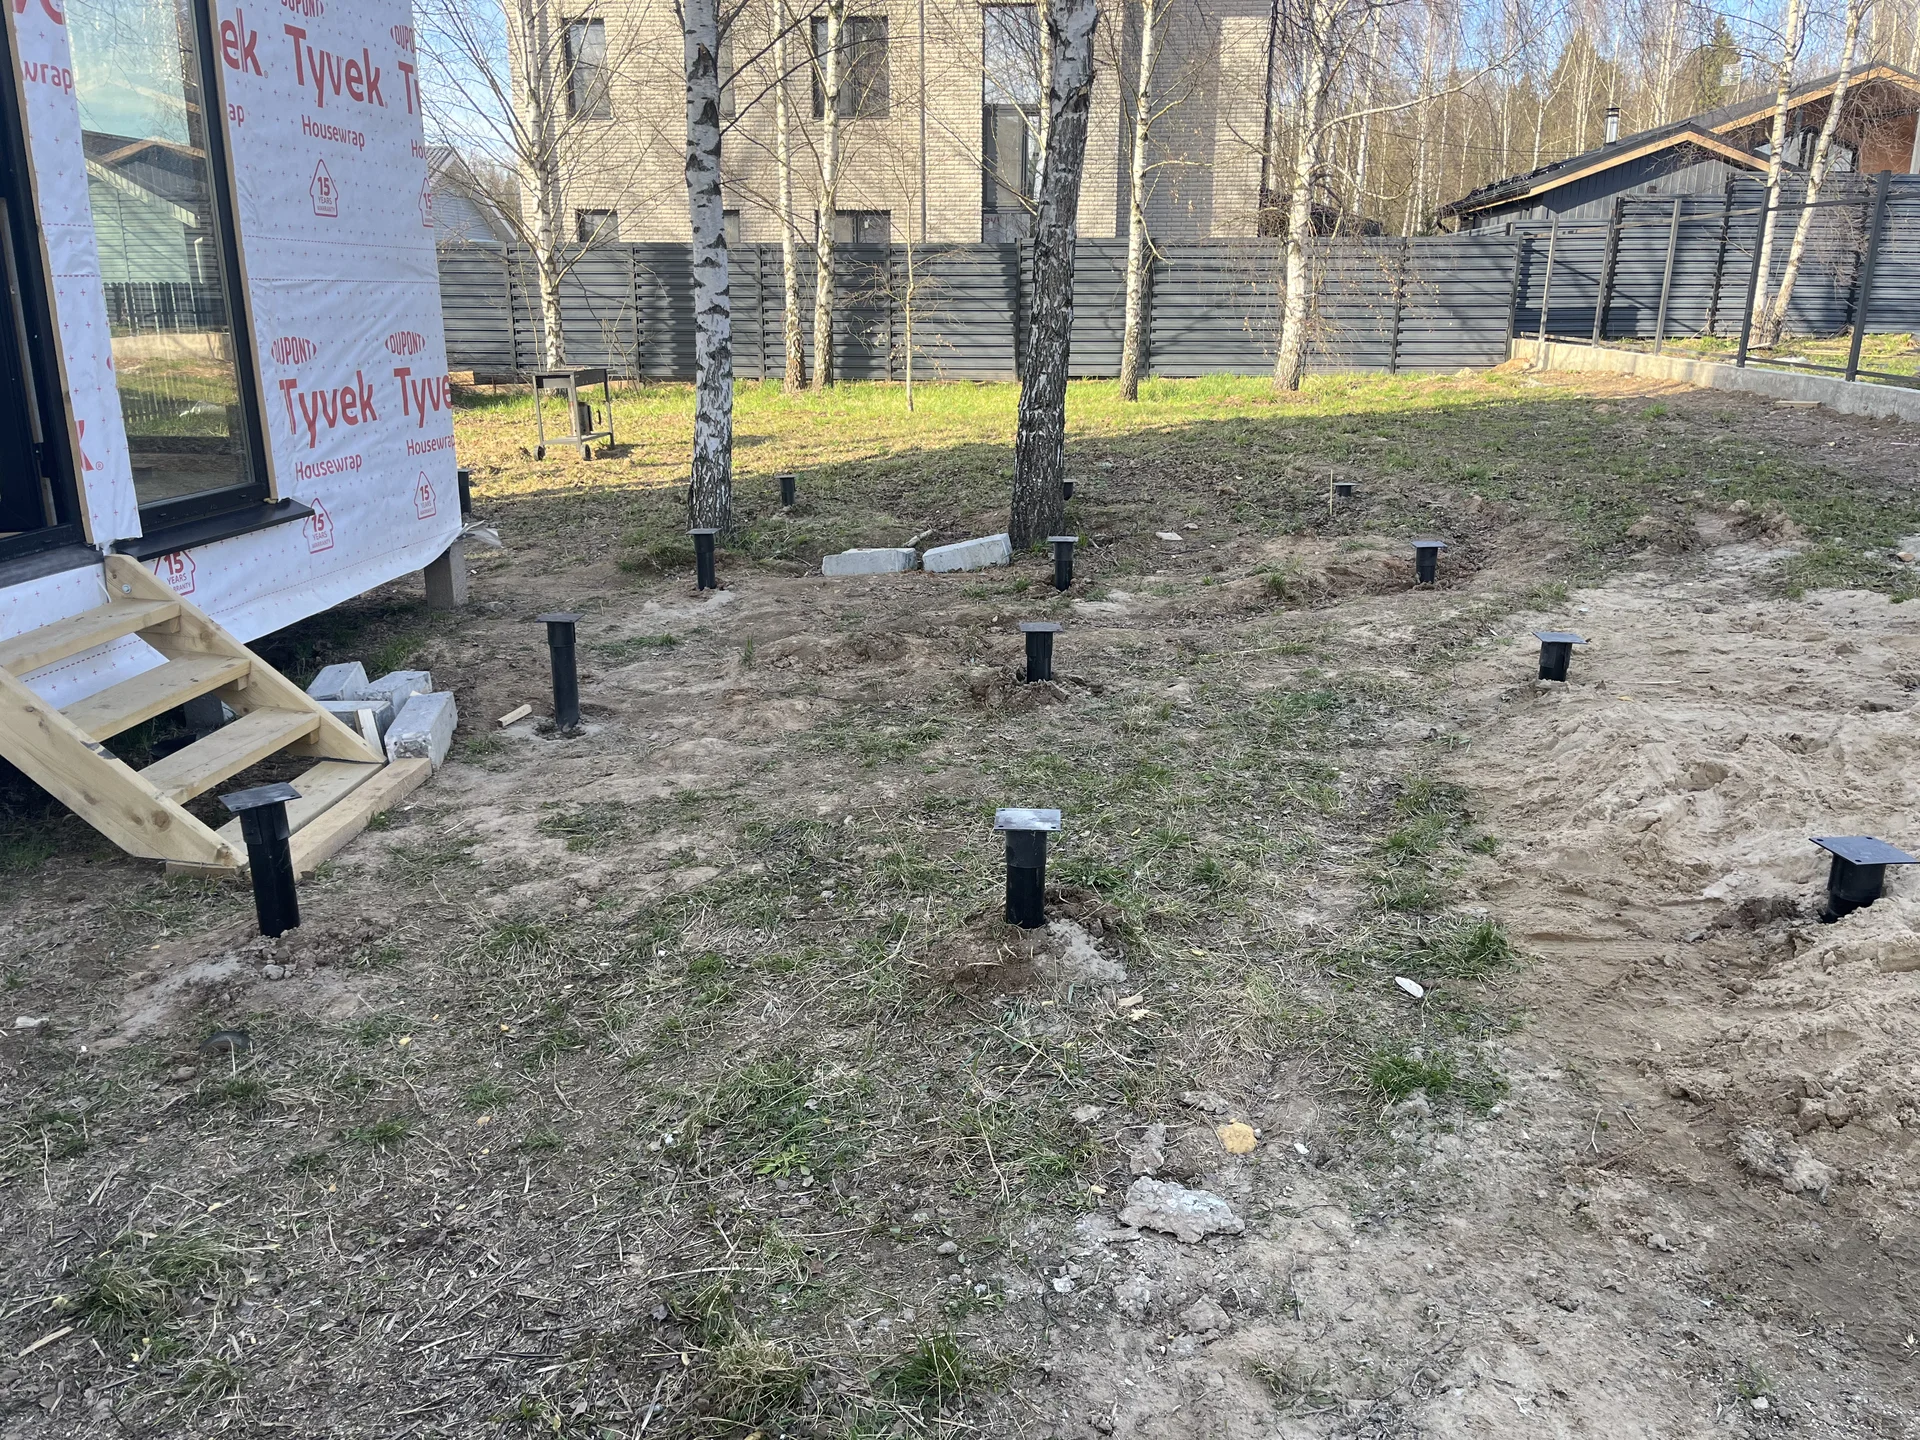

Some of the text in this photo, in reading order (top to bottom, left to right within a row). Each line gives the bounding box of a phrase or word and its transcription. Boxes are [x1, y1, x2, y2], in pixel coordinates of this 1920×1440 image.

[283, 23, 384, 109] Tyvek
[301, 114, 365, 152] Housewrap
[317, 176, 330, 196] 15
[273, 336, 311, 365] DUPONT
[390, 331, 421, 355] DUPONT
[279, 370, 378, 449] Tyvek
[295, 454, 362, 482] Housewrap
[420, 484, 430, 502] 15
[311, 513, 324, 532] 15
[312, 531, 328, 540] YEARS
[164, 551, 184, 575] 15
[167, 573, 187, 585] YEARS
